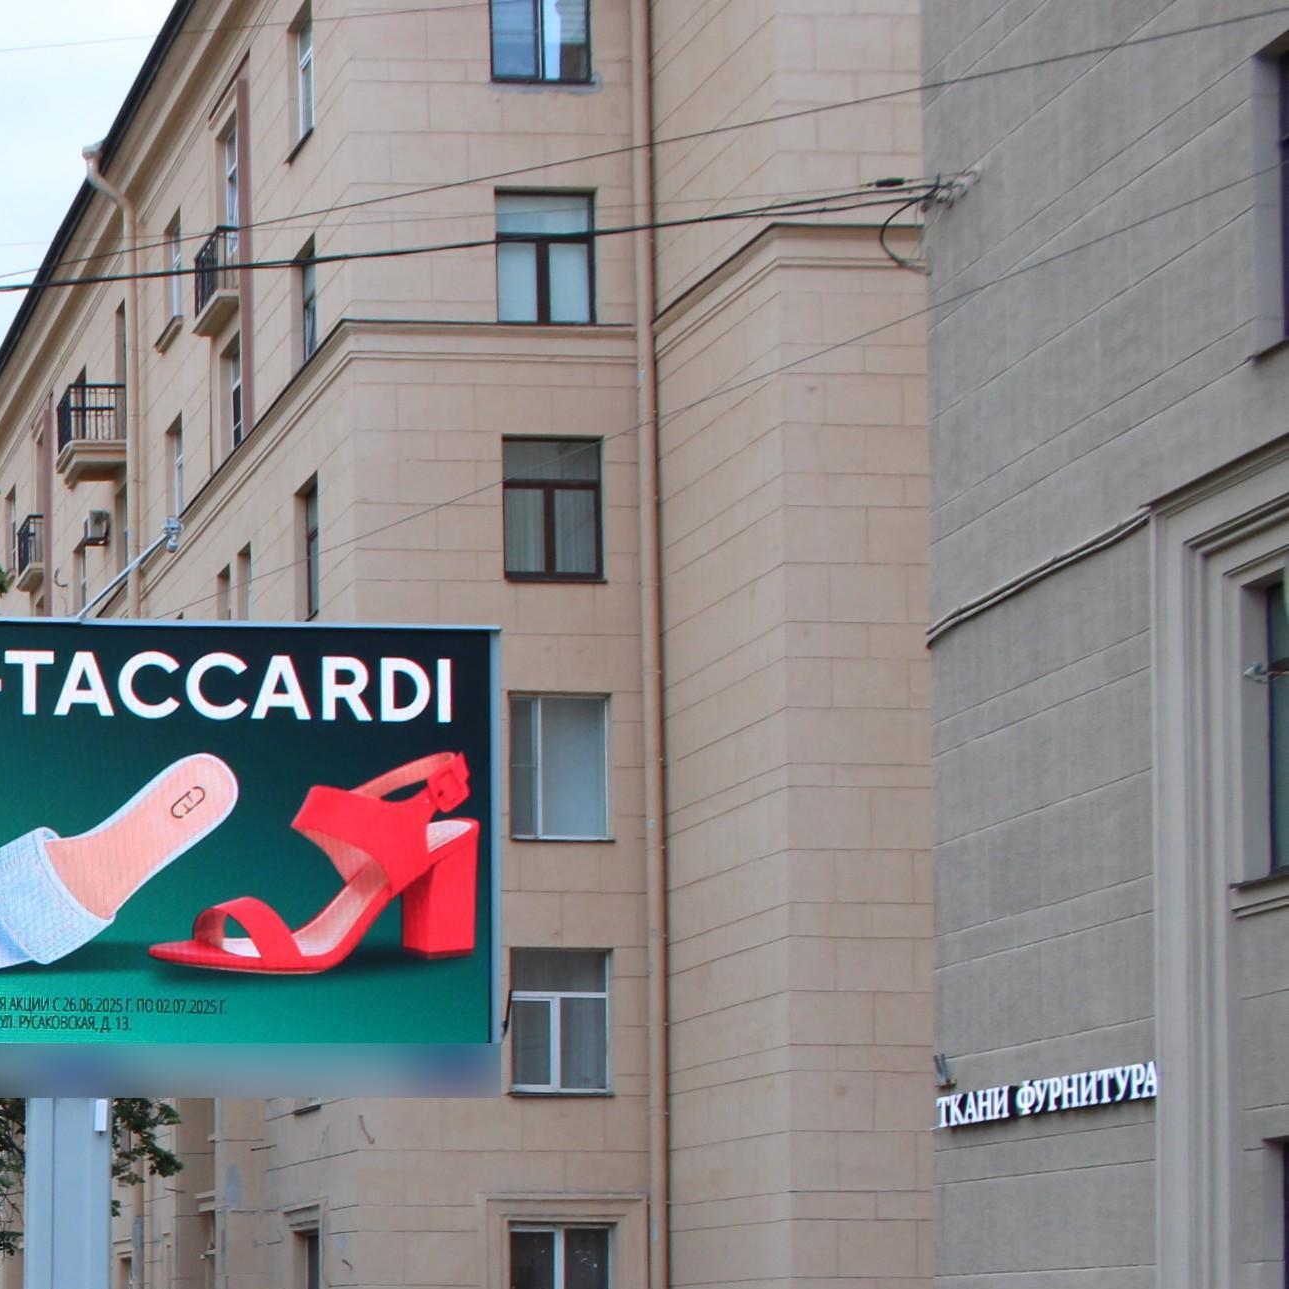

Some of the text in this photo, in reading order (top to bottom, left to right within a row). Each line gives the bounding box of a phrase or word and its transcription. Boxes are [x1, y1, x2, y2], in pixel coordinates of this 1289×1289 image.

[10, 996, 50, 1013] АКЦИИ
[52, 997, 62, 1012] С
[62, 997, 123, 1013] 26.06.2025
[125, 998, 134, 1013] Г.
[136, 999, 154, 1014] ПО
[156, 999, 218, 1014] 02.07.2025
[19, 1014, 99, 1031] РУСАКОВСКАЯ,
[936, 1060, 1158, 1128] ТКАНИ ФУРНИТУРА
